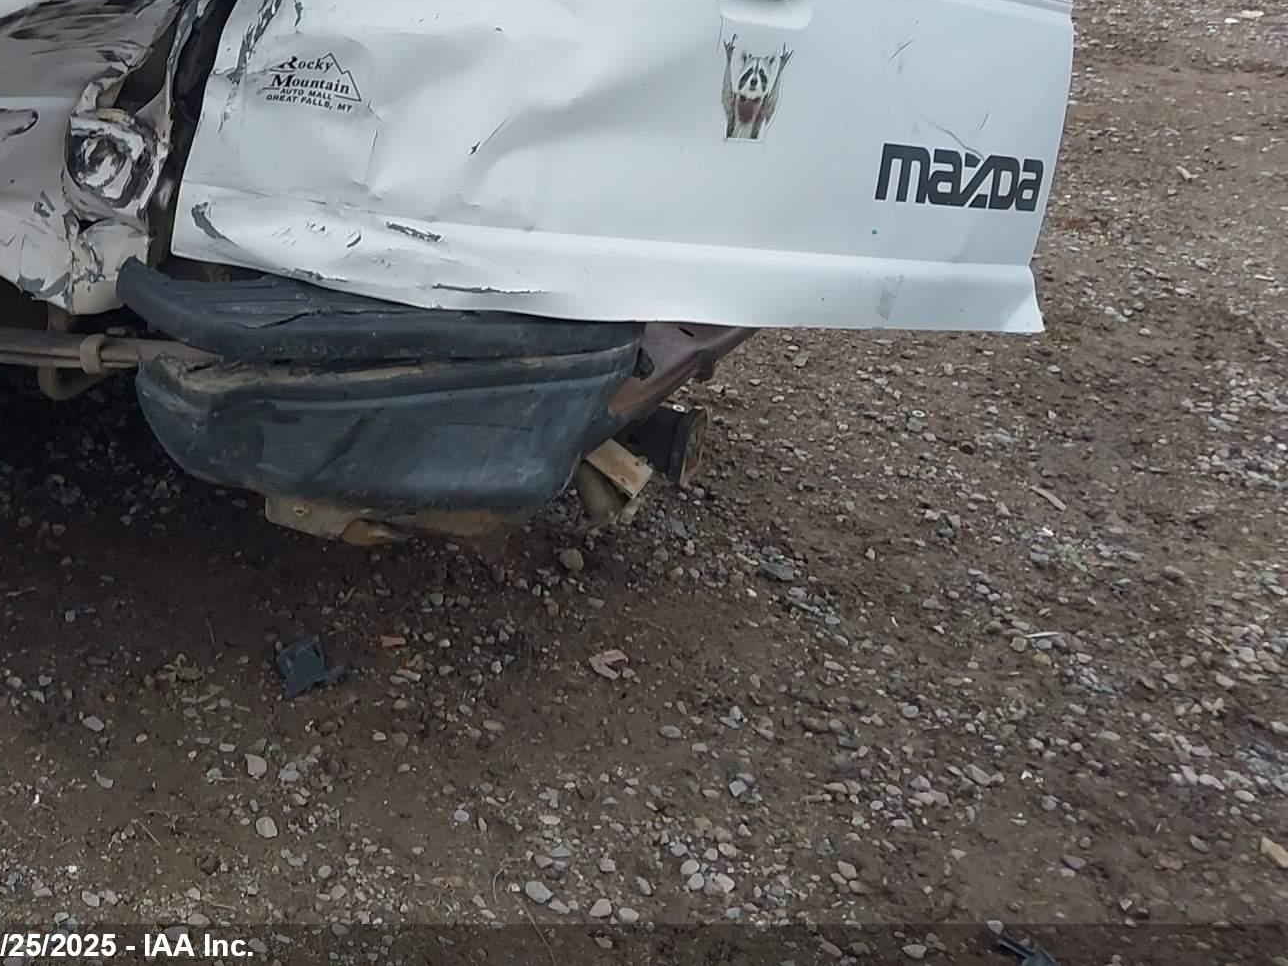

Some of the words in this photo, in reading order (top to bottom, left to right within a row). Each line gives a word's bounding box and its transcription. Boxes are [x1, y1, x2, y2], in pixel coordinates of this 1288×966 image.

[275, 55, 334, 73] Rocky
[270, 73, 350, 95] Mountain
[265, 93, 299, 103] GREAT
[300, 96, 334, 111] FALLS,
[336, 103, 353, 113] MT
[279, 88, 305, 96] AUTO
[308, 90, 333, 101] MALL
